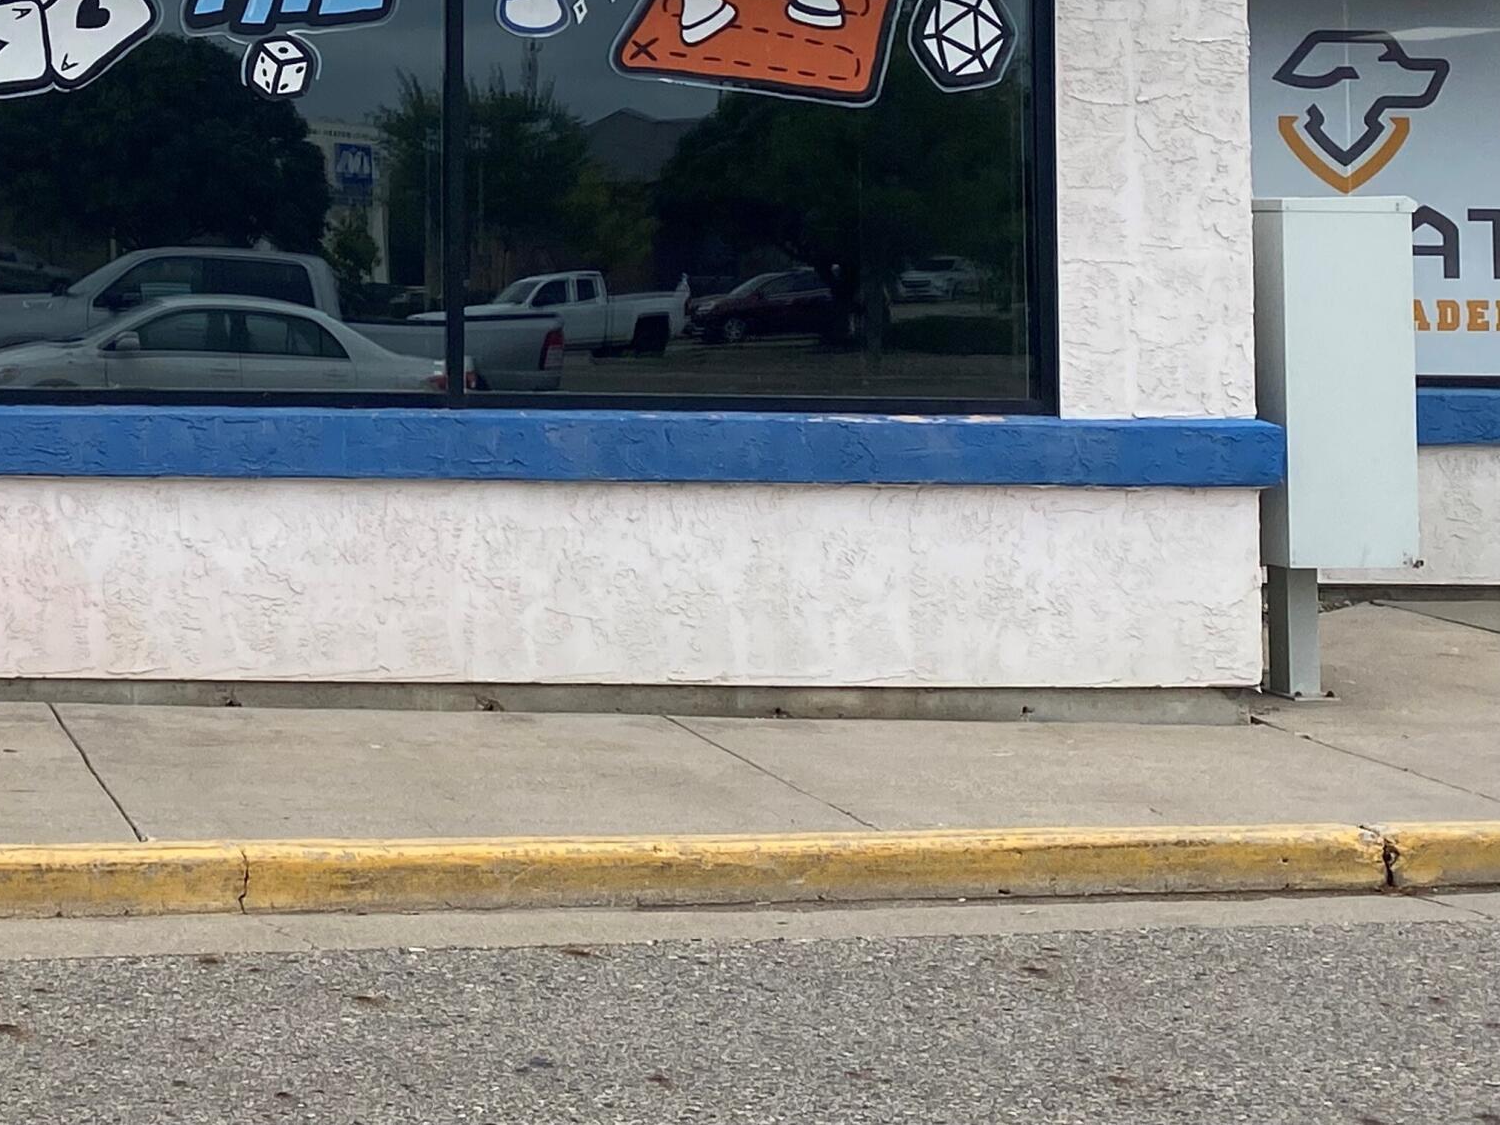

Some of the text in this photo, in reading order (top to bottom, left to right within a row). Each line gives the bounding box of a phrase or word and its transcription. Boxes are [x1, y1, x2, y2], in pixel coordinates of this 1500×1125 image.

[11, 7, 32, 20] A
[60, 53, 79, 72] A
[1413, 298, 1500, 331] ADE
